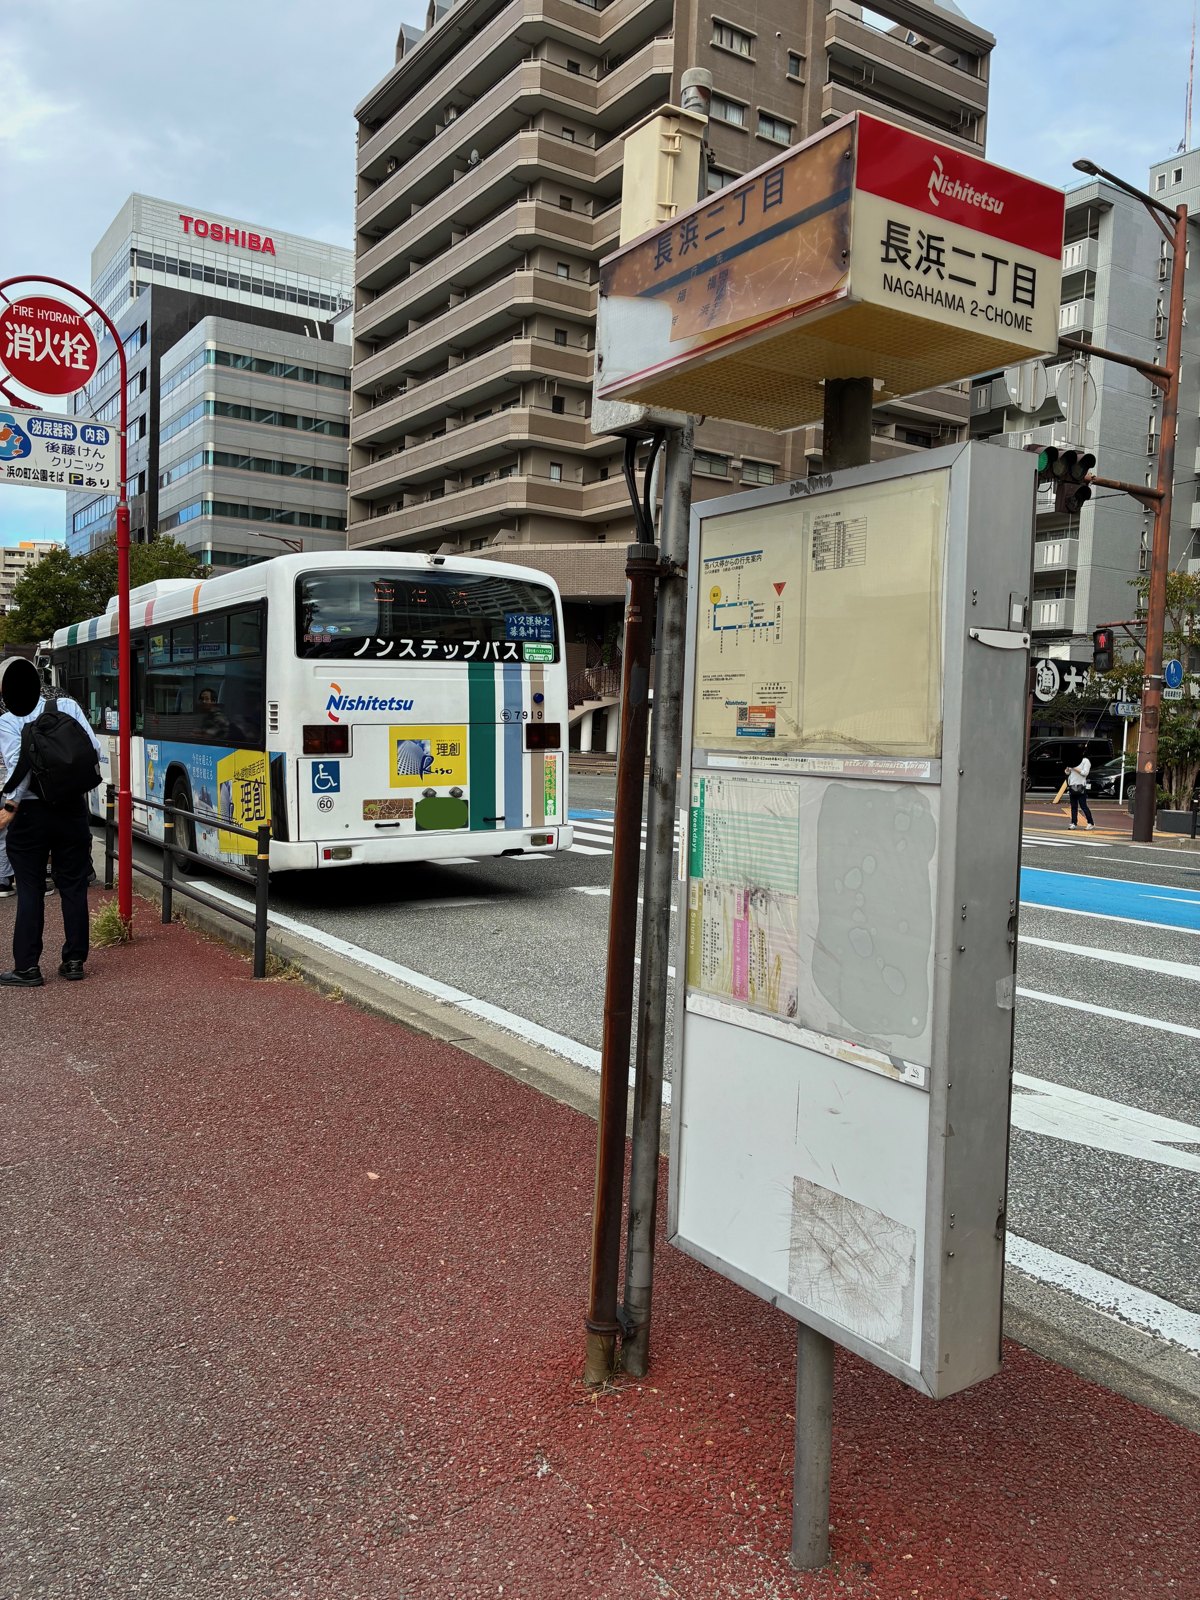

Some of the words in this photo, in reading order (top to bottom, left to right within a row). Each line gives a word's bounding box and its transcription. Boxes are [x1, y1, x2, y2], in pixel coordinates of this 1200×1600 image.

[928, 168, 1004, 215] Nishitetsu
[654, 167, 785, 271] 長浜二丁目
[179, 214, 277, 256] TOSHIBA
[880, 219, 1037, 309] 長浜二丁目
[13, 304, 34, 318] FIRE
[37, 308, 81, 326] HYDRANT
[883, 273, 966, 313] NAGAHAMA
[970, 300, 1033, 333] 2-CHOME
[5, 321, 91, 370] 消火栓
[31, 419, 74, 439] 泌尿器科
[85, 427, 107, 444] 内科
[45, 441, 105, 460] 後藤けん
[6, 465, 65, 483] 浜の町公園そば
[51, 456, 104, 472] クリニック
[353, 637, 519, 660] ノンステップバス
[326, 694, 414, 711] Nishitetsu
[436, 742, 461, 757] 理創
[241, 775, 266, 822] 理創
[319, 799, 332, 809] 60
